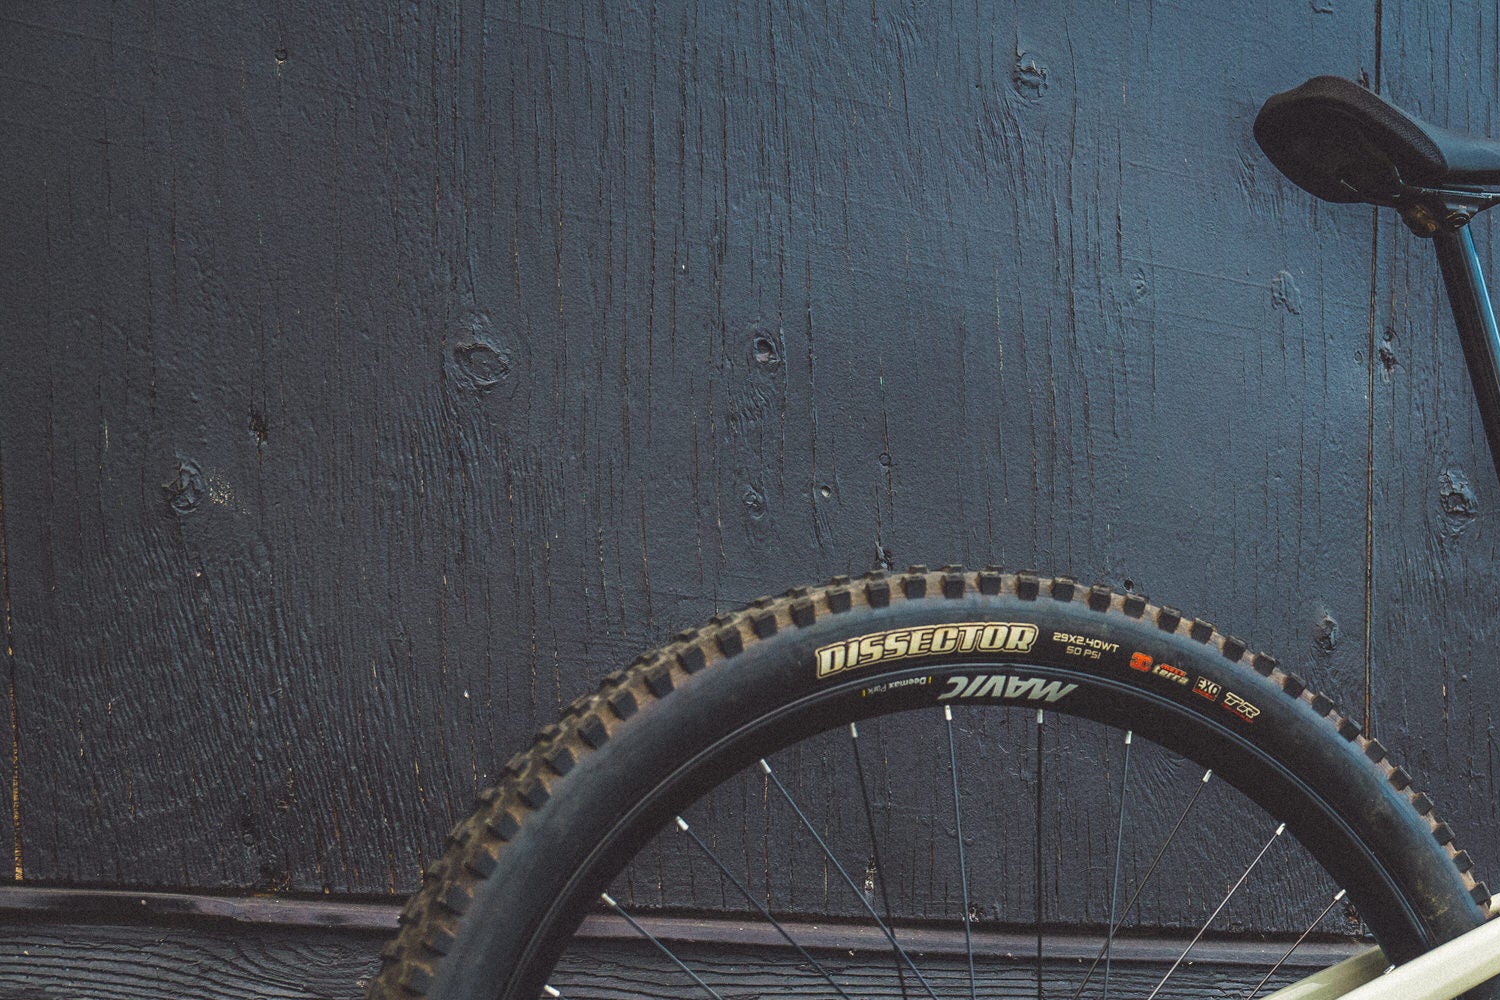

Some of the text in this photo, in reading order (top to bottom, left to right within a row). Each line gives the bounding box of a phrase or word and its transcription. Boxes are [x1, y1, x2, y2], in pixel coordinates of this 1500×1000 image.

[816, 621, 1039, 679] DISSECTOR
[1053, 632, 1119, 653] 29X2.40WT
[1066, 645, 1102, 660] 50 PSI
[888, 676, 927, 690] Deemax
[938, 675, 1079, 702] MAVIC
[1196, 677, 1222, 697] EXO
[1223, 691, 1261, 719] TR
